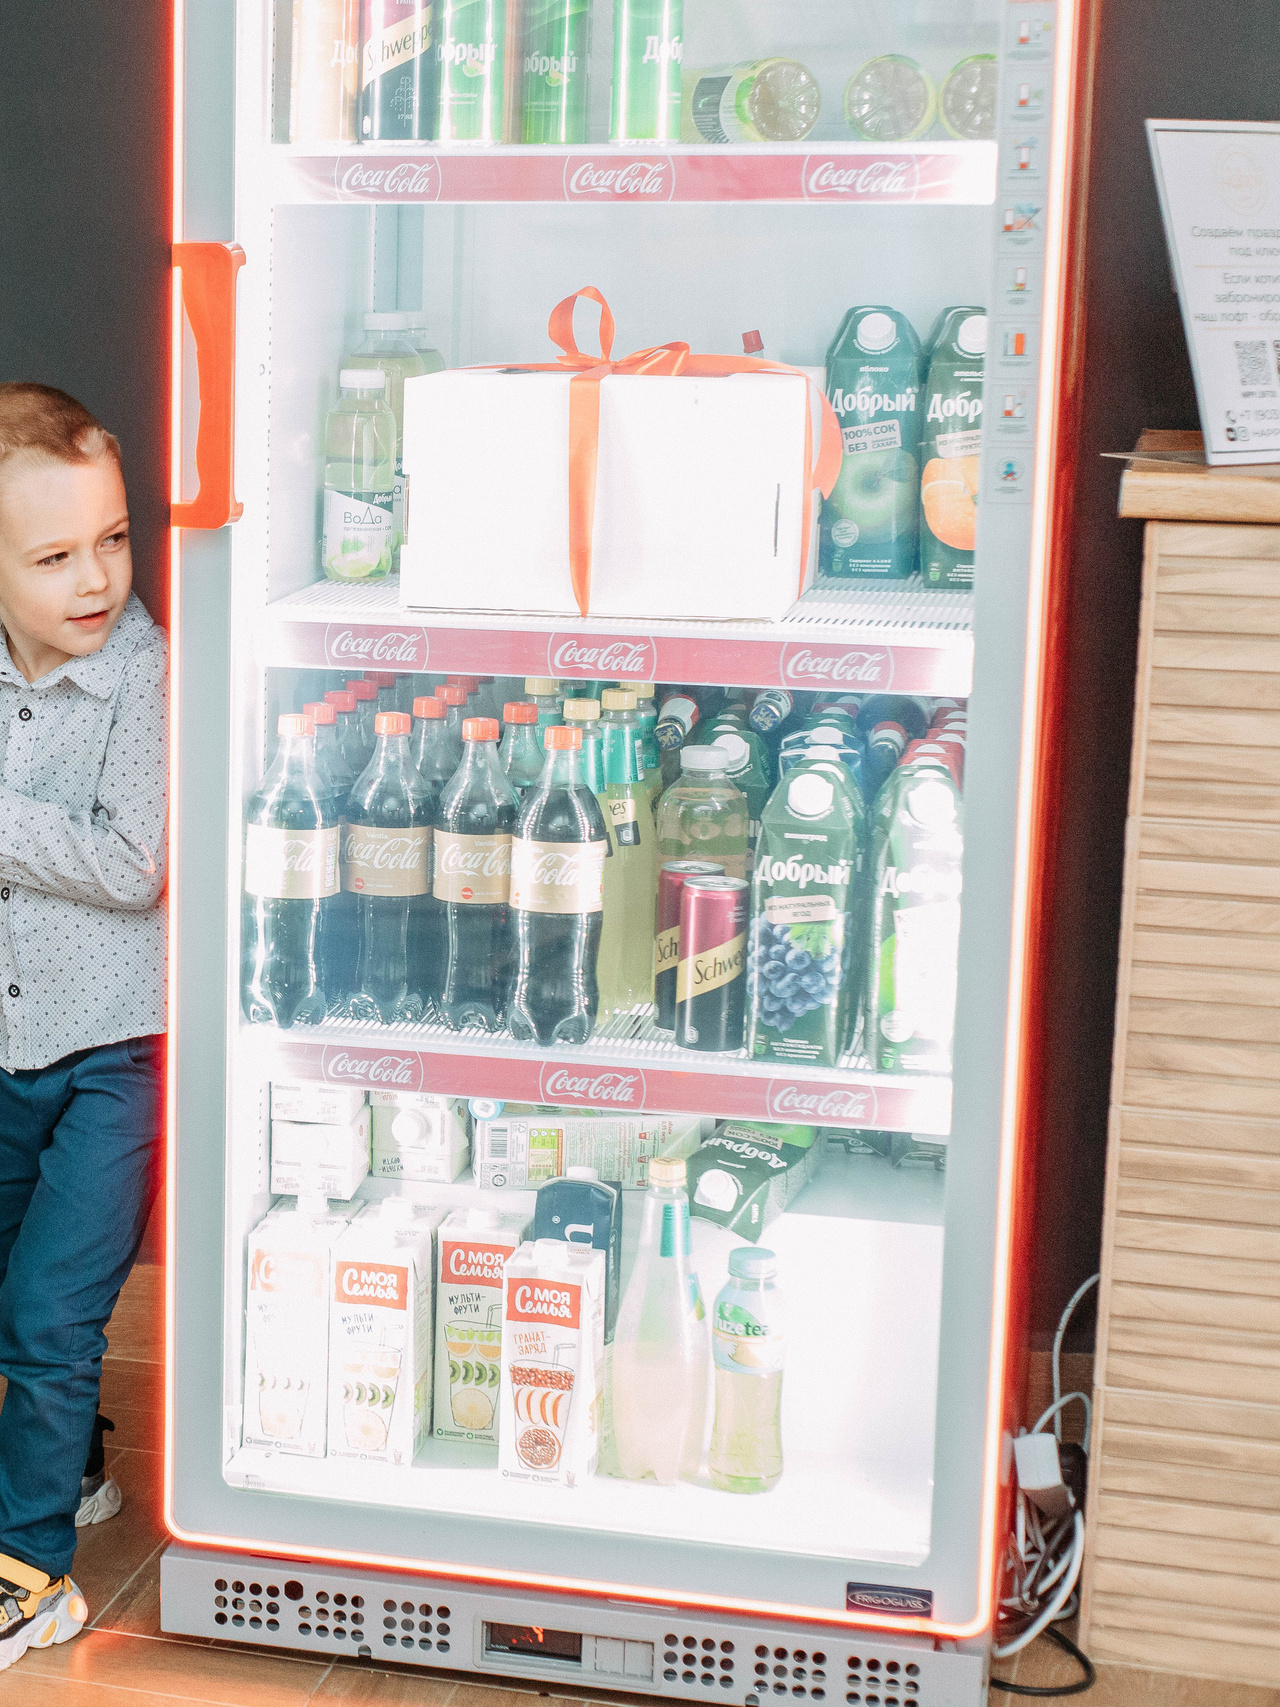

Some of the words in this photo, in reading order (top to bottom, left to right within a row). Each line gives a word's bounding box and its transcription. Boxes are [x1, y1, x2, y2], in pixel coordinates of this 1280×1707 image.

[524, 50, 579, 75] обрый
[341, 162, 435, 194] Coca-Cola
[569, 162, 668, 195] Coca-Cola
[808, 161, 910, 194] Coca-Cola
[1247, 228, 1280, 238] празд
[1255, 247, 1280, 256] клю
[1223, 272, 1250, 284] Если
[1254, 274, 1280, 284] хоти
[1215, 291, 1280, 304] заброниро
[1259, 308, 1280, 323] обр
[831, 386, 916, 418] Добрый
[927, 391, 983, 424] Добр
[843, 427, 872, 441] 100%
[873, 424, 897, 436] СОК
[848, 441, 868, 453] БЕЗ
[330, 629, 421, 662] Coca-Cola
[553, 637, 649, 673] Coca-Cola
[786, 646, 886, 683] Coca-Cola
[345, 834, 425, 870] Coca-Cola
[441, 843, 512, 877] Coca-Co
[755, 854, 851, 889] Добрый
[328, 1052, 418, 1085] Coca-Cola
[545, 1069, 639, 1102] Coca-Cola
[772, 1087, 871, 1119] Coca-Cola
[449, 1249, 505, 1280] Семья
[468, 1251, 505, 1267] МОЯ
[342, 1268, 399, 1300] Семья
[360, 1269, 397, 1287] МОЯ
[449, 1294, 486, 1306] МУЛЬТИ-
[453, 1304, 480, 1315] ФРУТИ
[515, 1286, 572, 1318] Семья
[534, 1287, 571, 1305] МОЯ
[347, 1323, 373, 1335] ФРУТИ
[513, 1331, 551, 1345] ГРАНАТ-
[518, 1343, 547, 1355] ЗАРЯД
[855, 1594, 924, 1609] FRIGOGLASS
